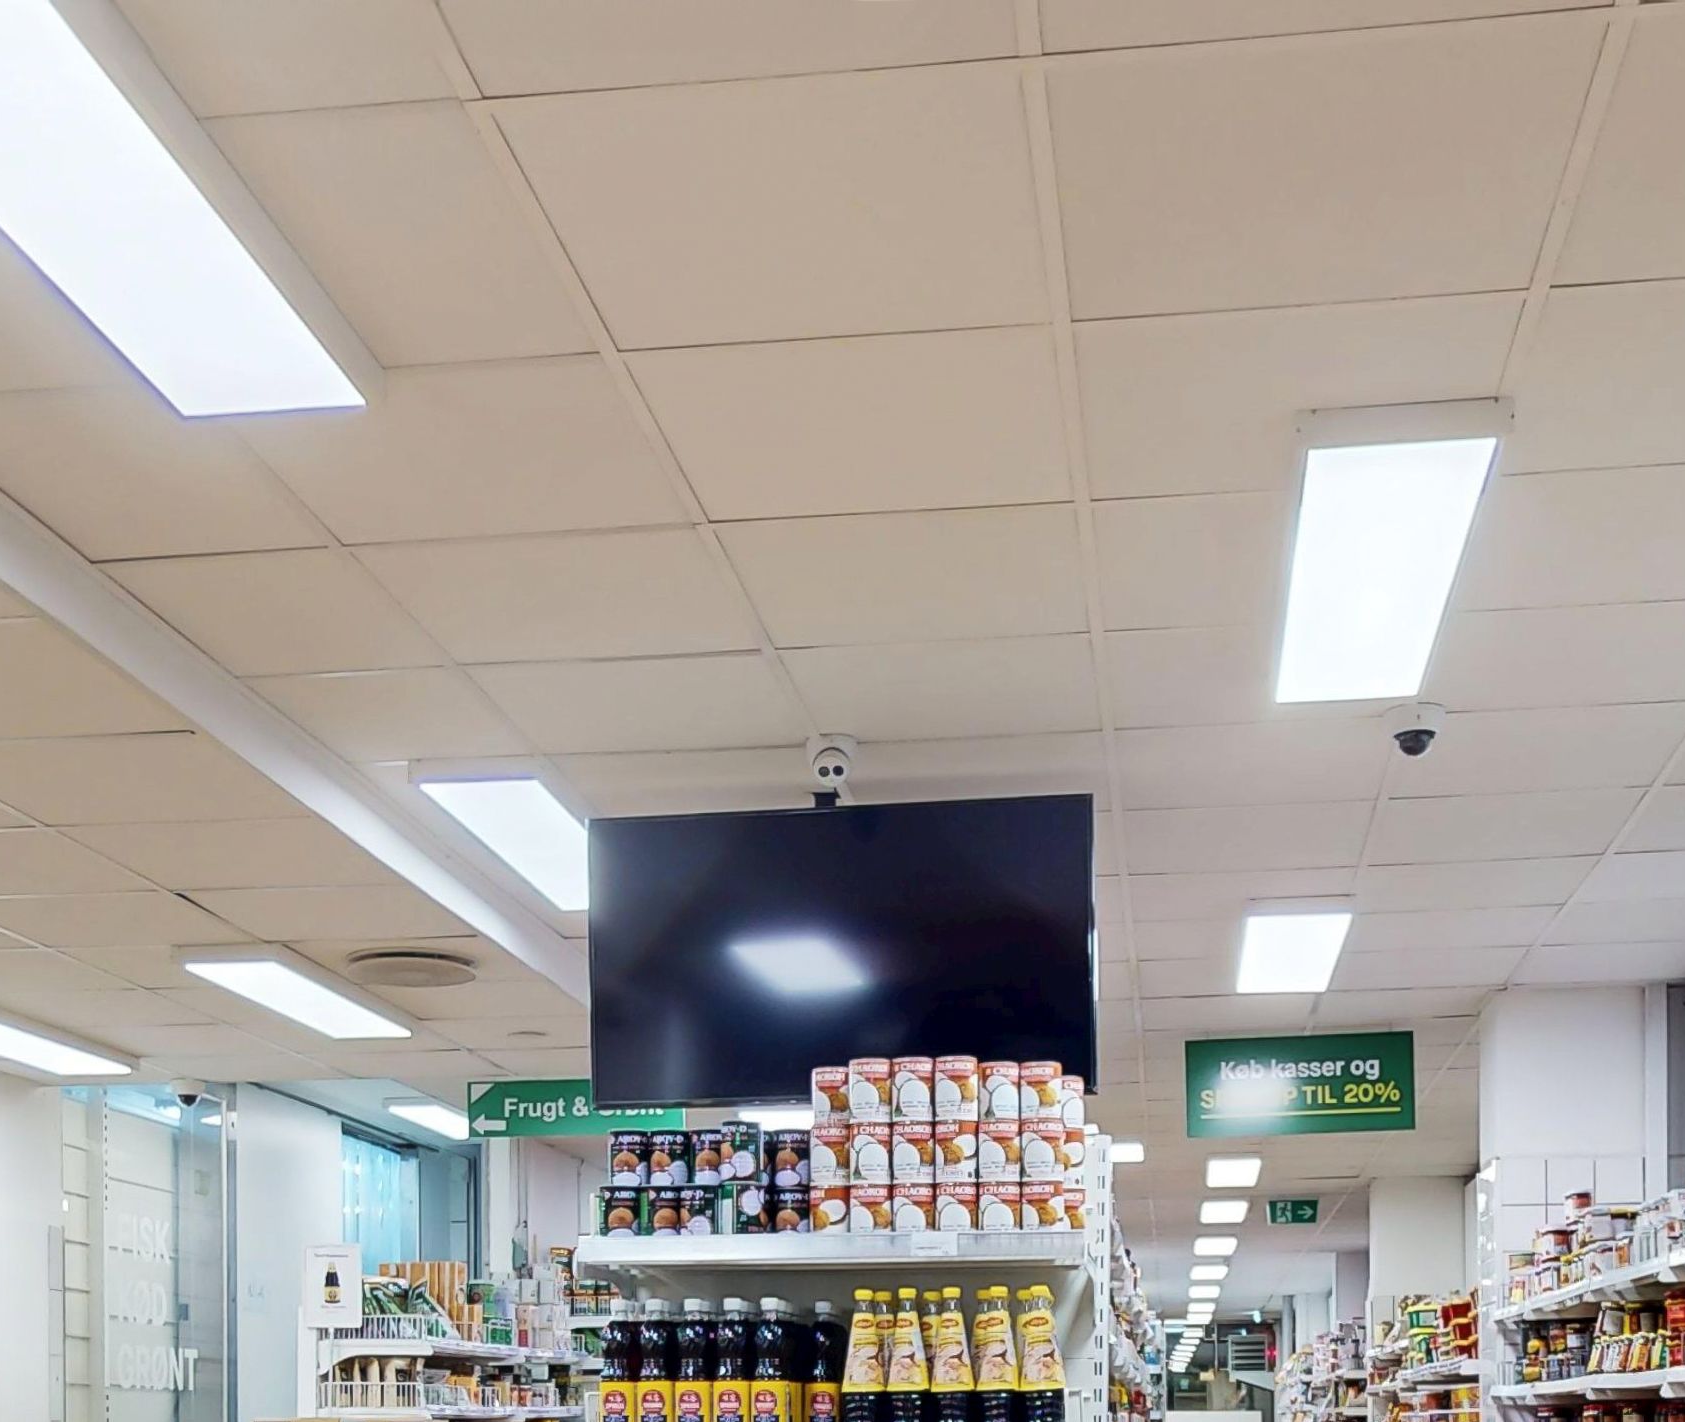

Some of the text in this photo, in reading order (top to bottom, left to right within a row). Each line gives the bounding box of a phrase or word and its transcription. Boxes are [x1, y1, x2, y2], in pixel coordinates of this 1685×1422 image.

[1220, 1058, 1381, 1081] Køb kasser og
[1302, 1085, 1337, 1105] TIL
[1344, 1080, 1401, 1104] 20%
[504, 1096, 590, 1122] Frugt &
